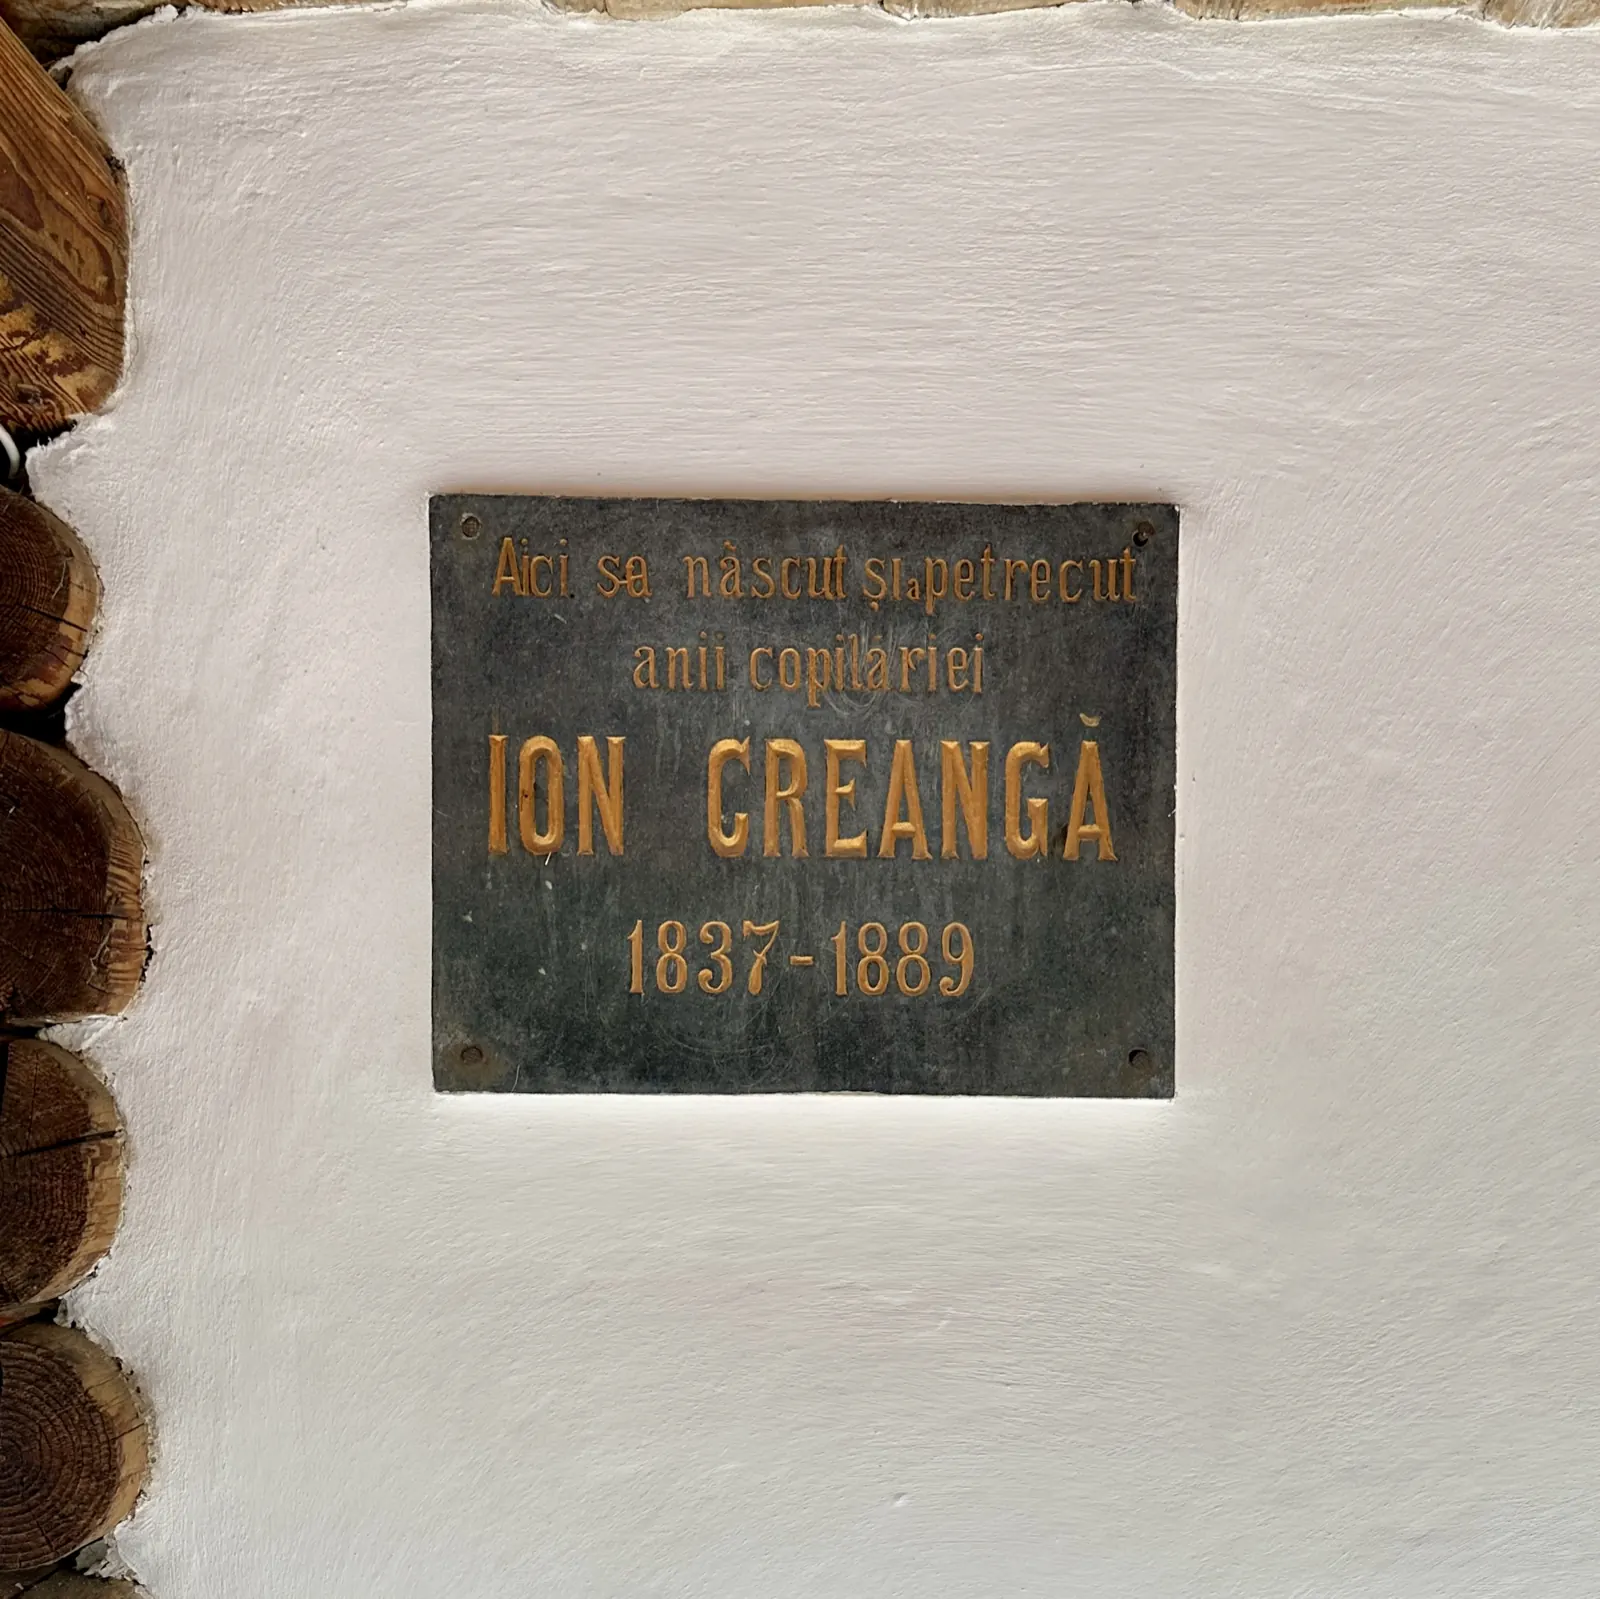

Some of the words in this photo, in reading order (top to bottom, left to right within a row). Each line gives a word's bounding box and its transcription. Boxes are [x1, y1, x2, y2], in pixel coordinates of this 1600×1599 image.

[491, 535, 569, 598] Aici
[632, 631, 727, 691] anii
[487, 730, 626, 858] ION
[706, 713, 1119, 862] CREANGĂ
